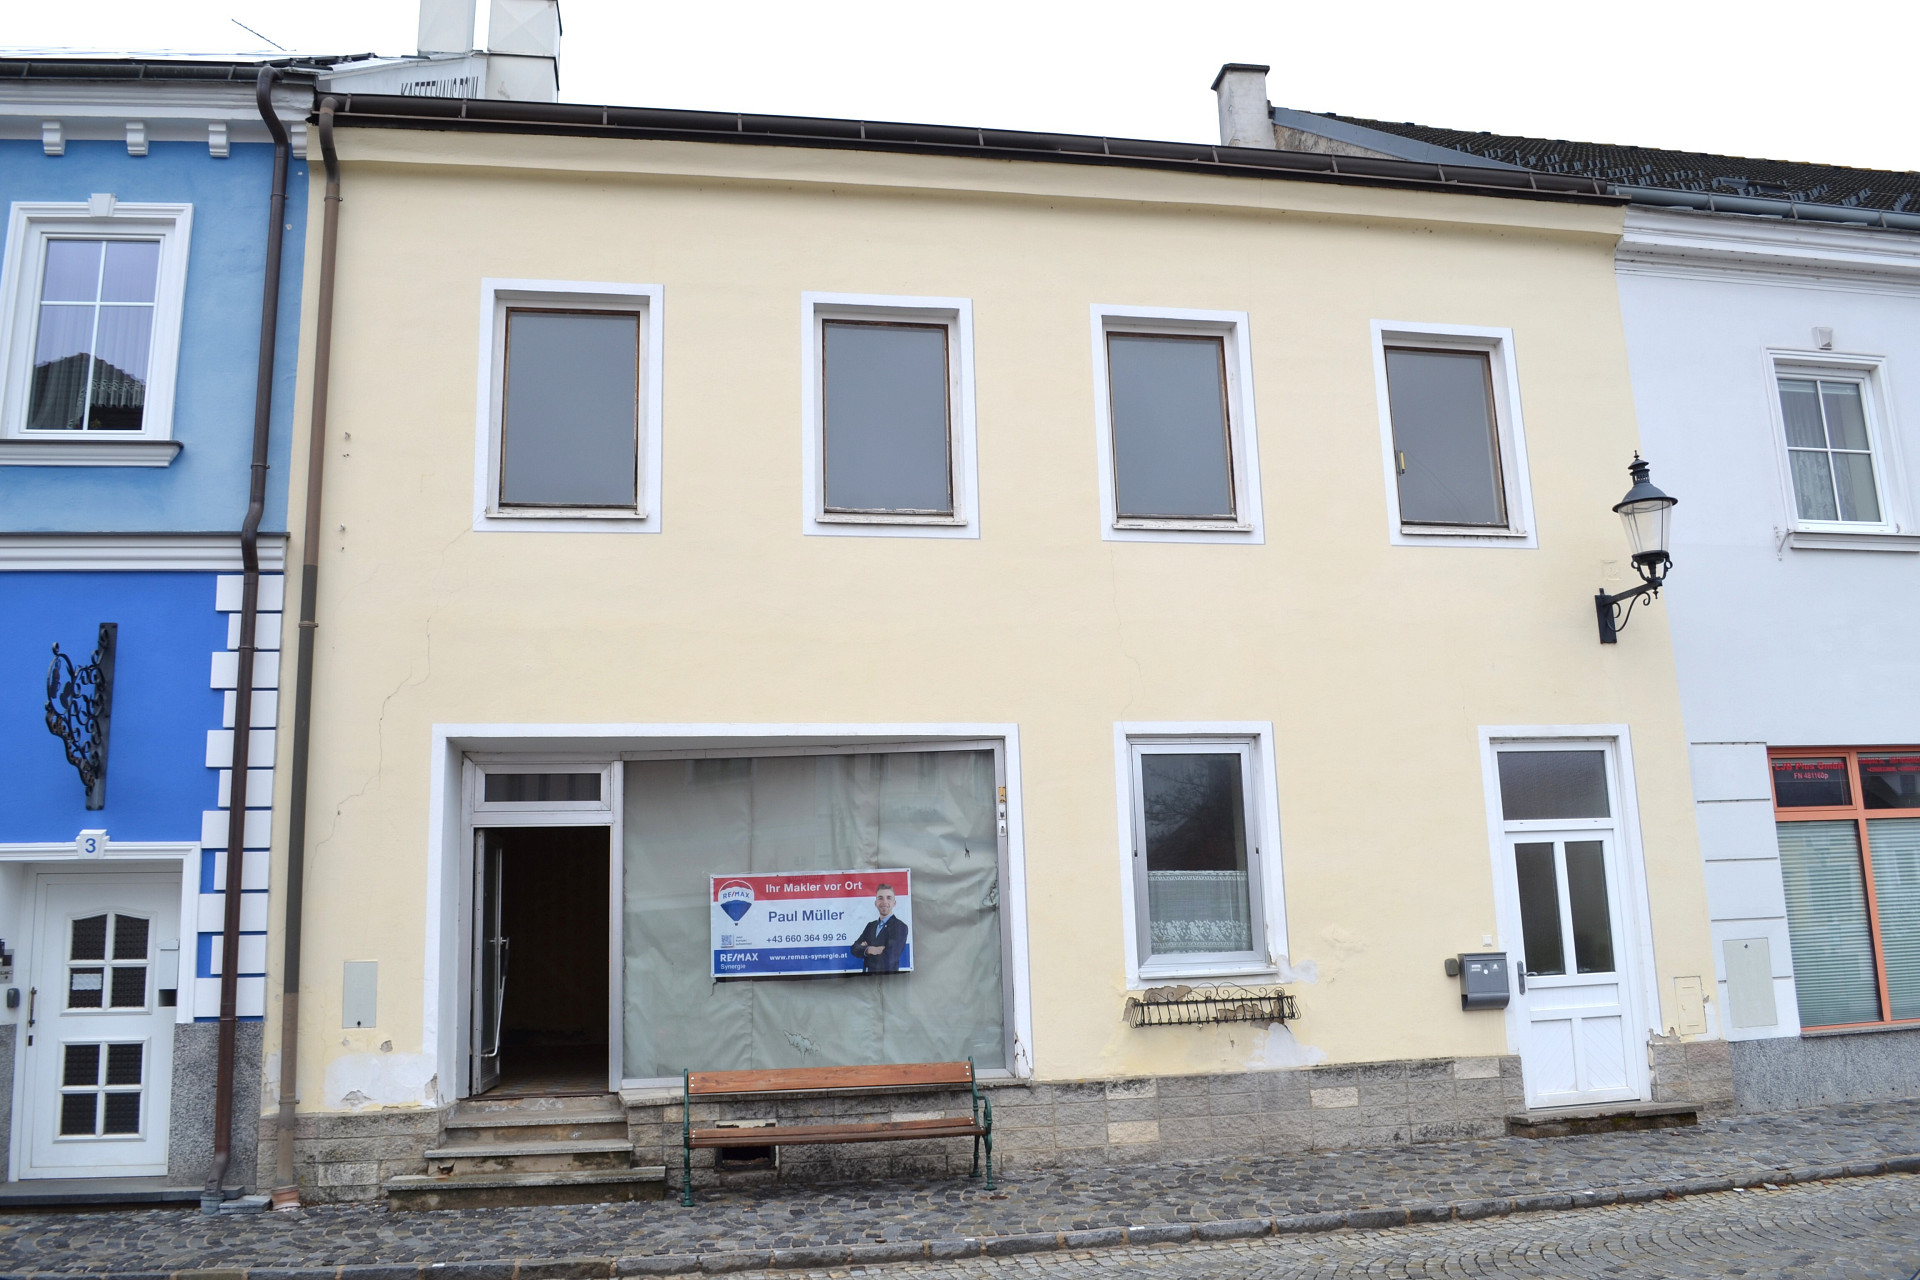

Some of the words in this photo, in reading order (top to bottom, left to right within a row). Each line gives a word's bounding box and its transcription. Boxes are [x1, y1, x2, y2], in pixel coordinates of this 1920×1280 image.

[1793, 772, 1803, 780] FN
[85, 838, 96, 853] 3
[765, 884, 781, 893] Ihr
[784, 882, 821, 893] Makler
[824, 883, 842, 891] vor
[844, 880, 863, 890] Ort
[722, 891, 750, 899] RE/MAX
[768, 910, 798, 922] Paul
[802, 909, 845, 922] Müller
[766, 935, 783, 943] +43
[785, 934, 802, 943] 660
[804, 933, 820, 942] 364
[822, 933, 834, 942] 99
[836, 933, 847, 941] 26
[720, 953, 759, 962] RE/MAX
[769, 952, 848, 962] www.remax-synergie.at
[720, 963, 746, 971] Synergie
